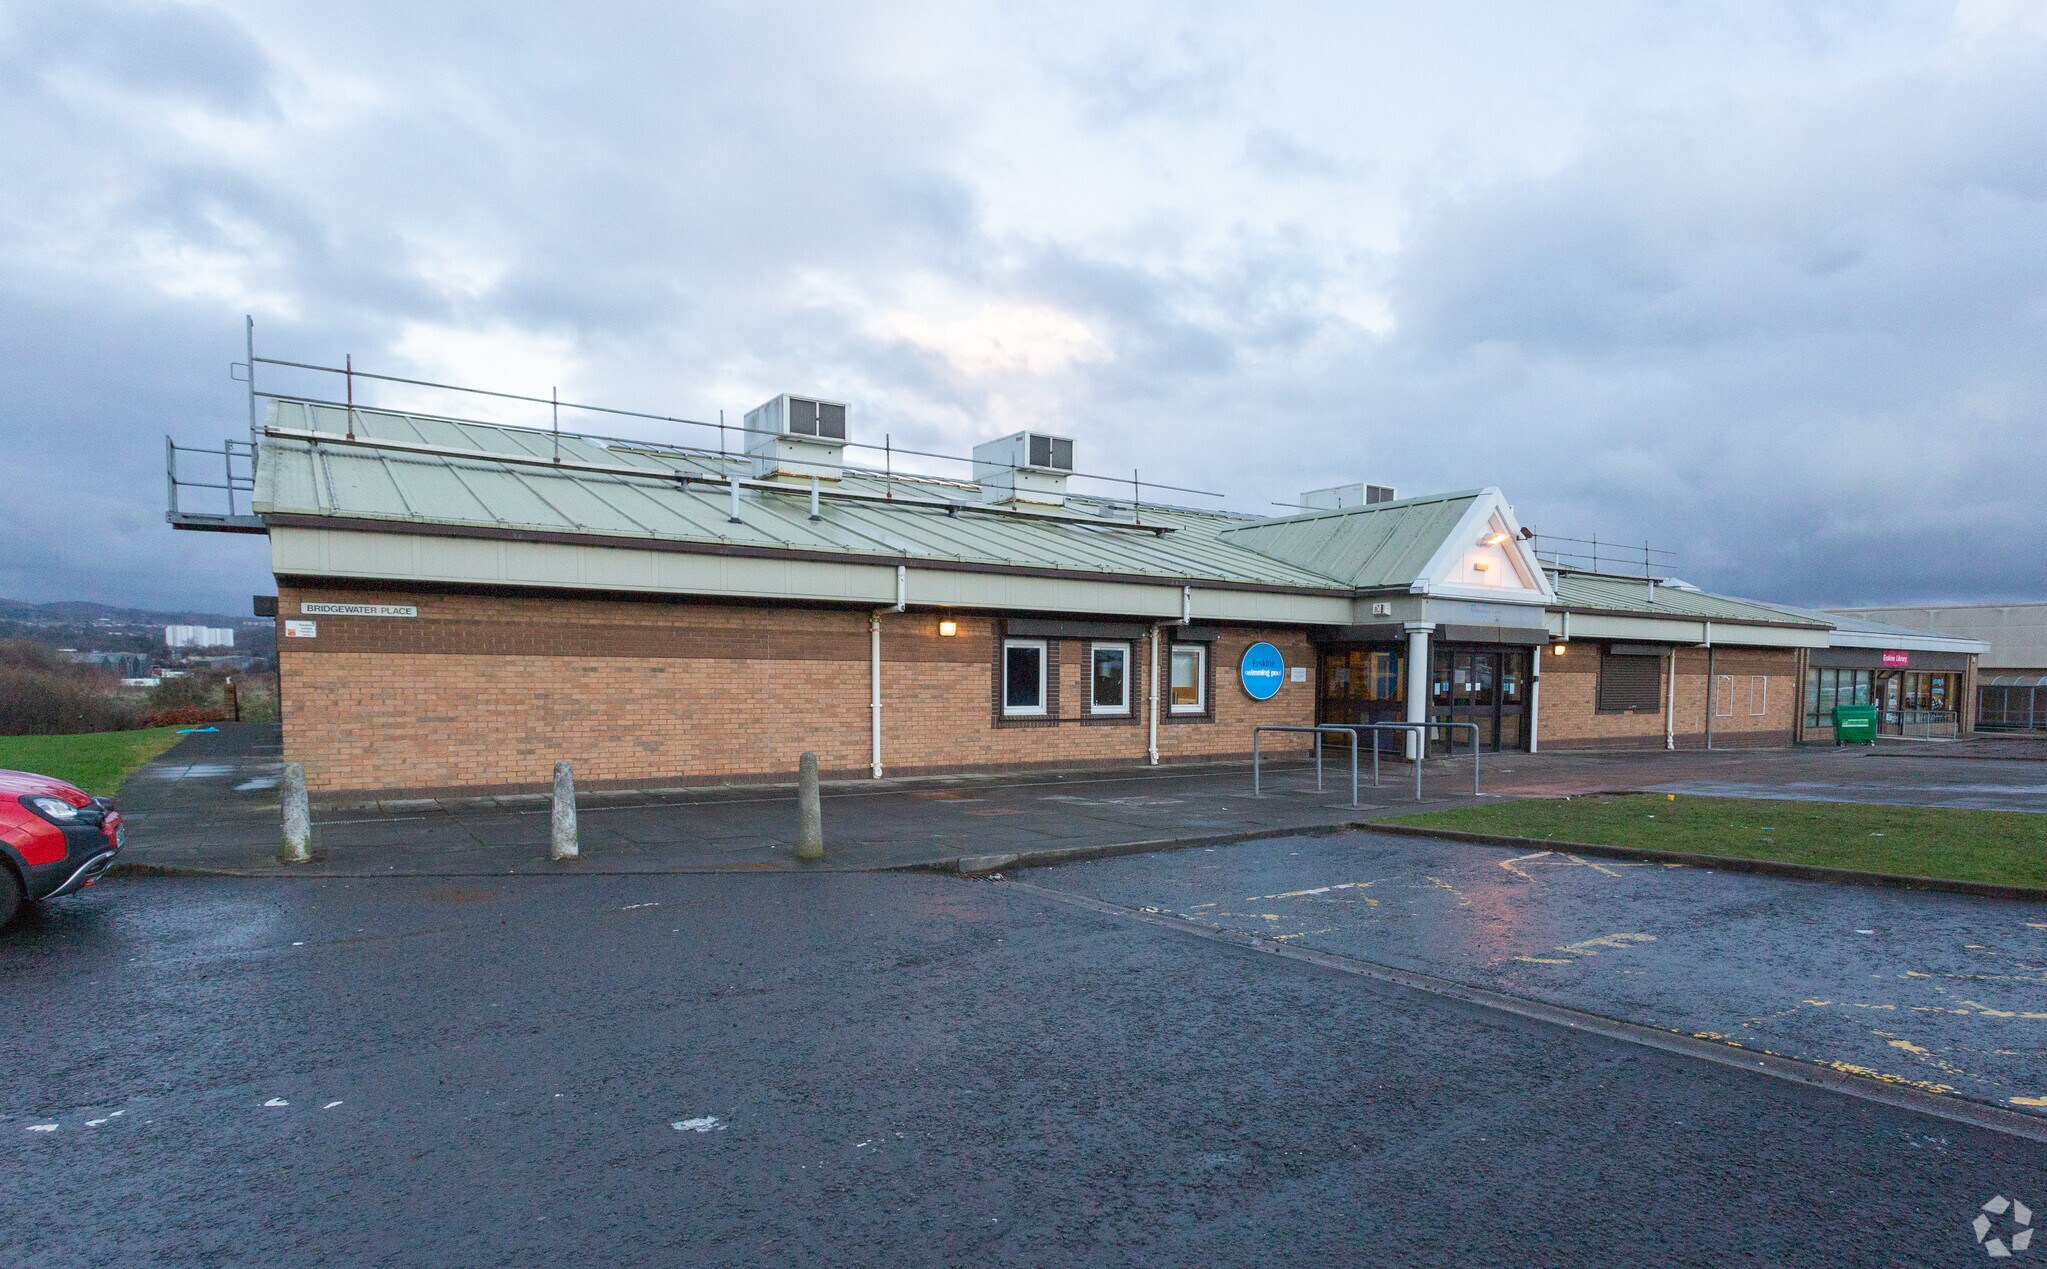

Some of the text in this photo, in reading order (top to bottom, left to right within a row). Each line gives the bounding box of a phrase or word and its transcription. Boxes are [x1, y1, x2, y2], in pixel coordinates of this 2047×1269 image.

[306, 604, 412, 615] BRIDGEWATER PLACE
[1252, 659, 1276, 668] Erskine
